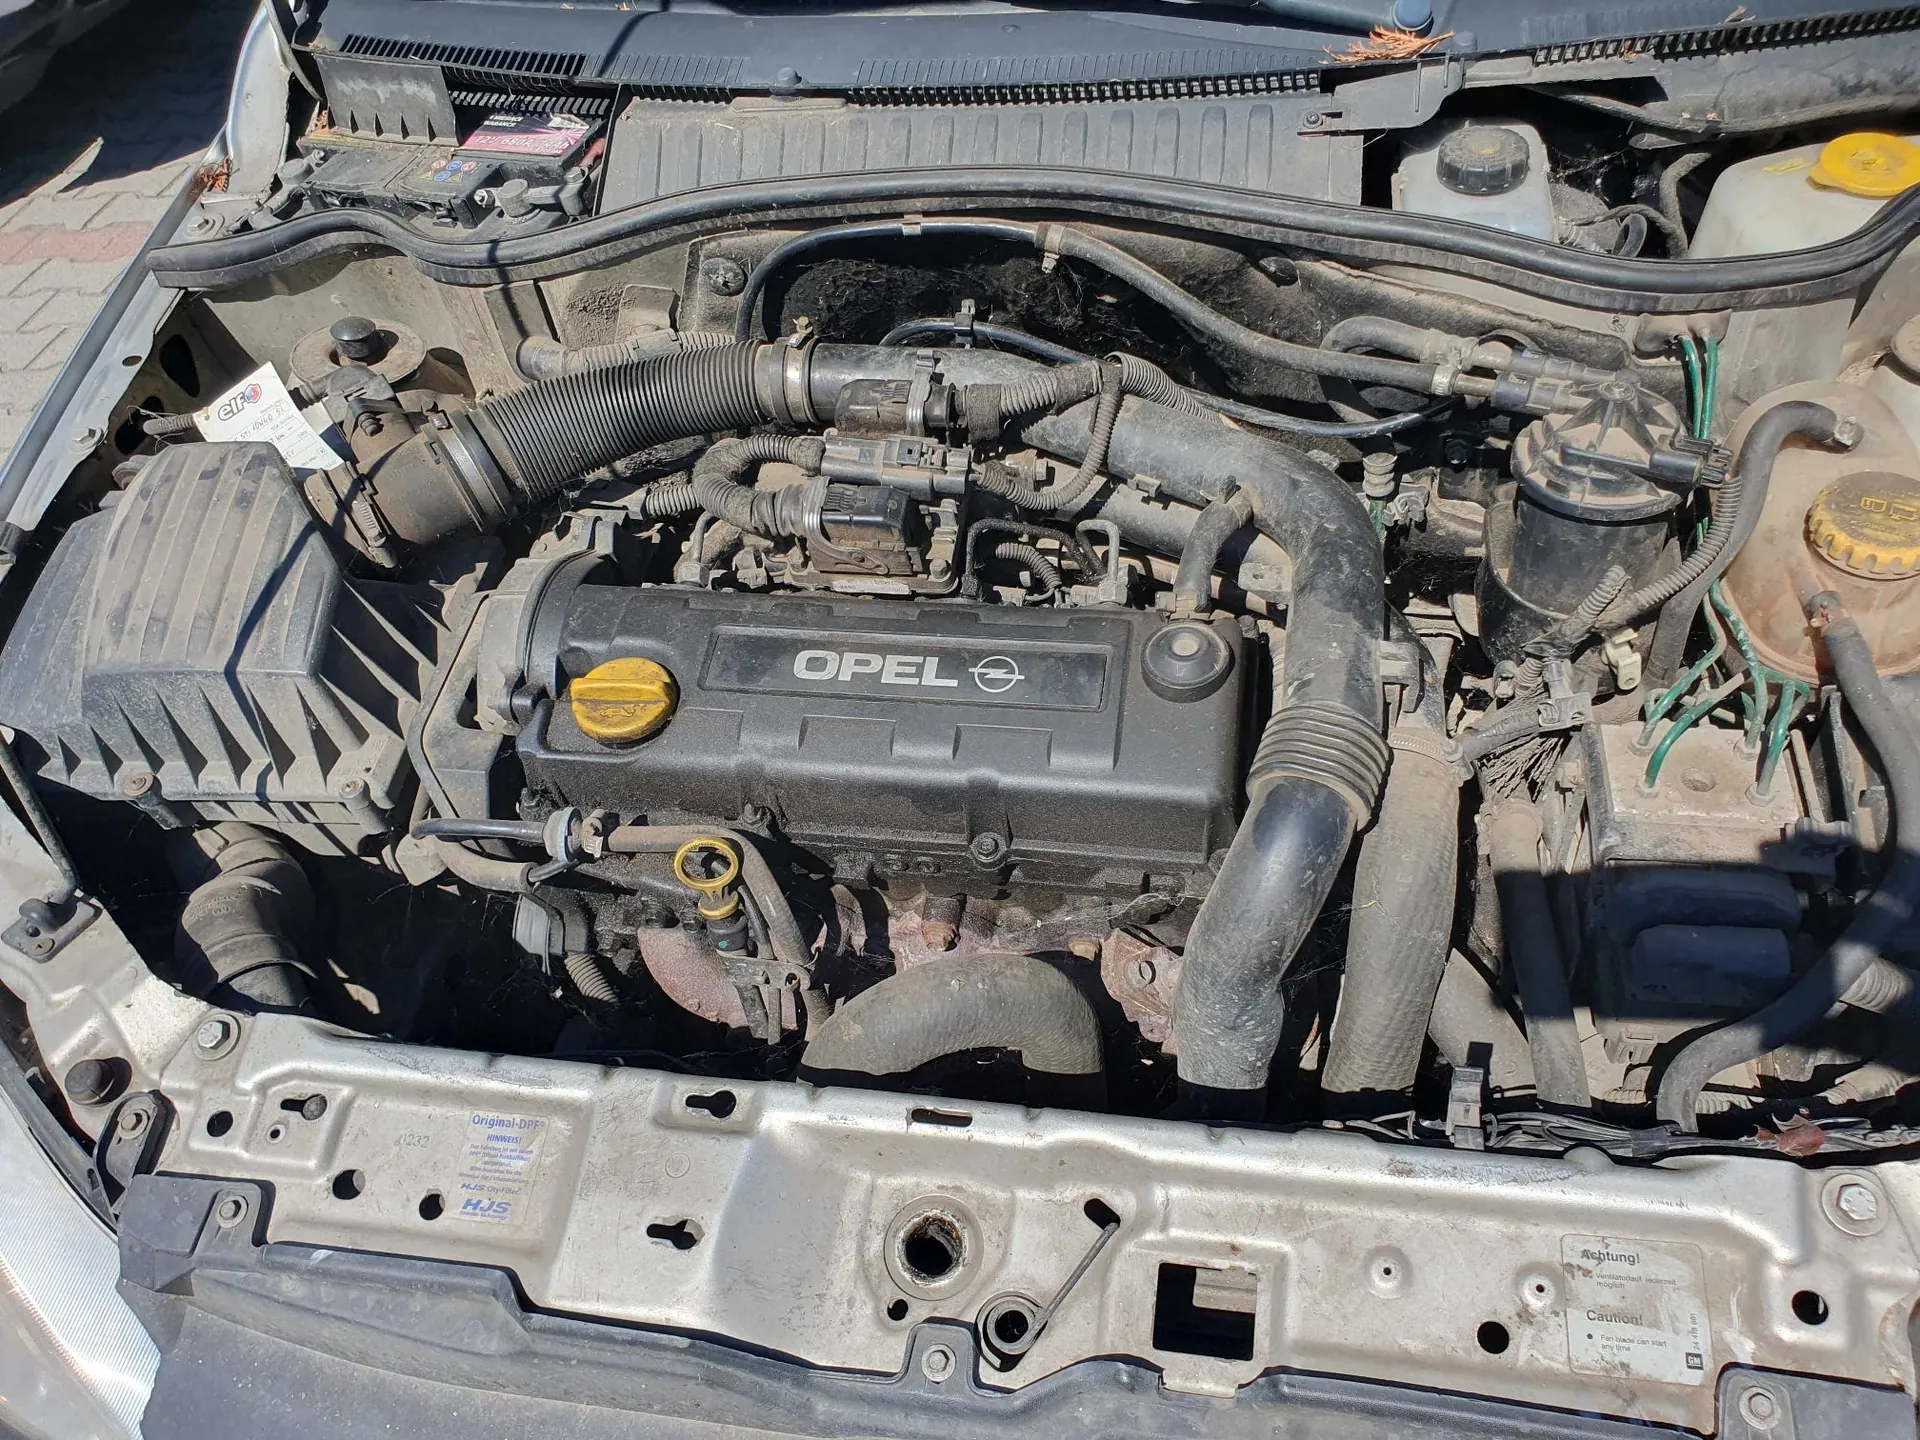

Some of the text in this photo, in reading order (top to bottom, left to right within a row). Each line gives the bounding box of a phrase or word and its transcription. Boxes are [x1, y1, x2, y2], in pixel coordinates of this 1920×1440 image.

[475, 135, 498, 144] 12V
[218, 391, 246, 421] elf
[793, 649, 959, 688] OPEL
[486, 1133, 523, 1144] HINWEIS!
[460, 1182, 486, 1191] HJS
[461, 1198, 512, 1214] HJS
[1580, 1249, 1641, 1266] Achtung!
[1596, 1281, 1626, 1290] möglich
[1586, 1309, 1644, 1326] Caution!
[1600, 1334, 1614, 1342] Fan
[1614, 1335, 1635, 1344] blade
[1651, 1339, 1667, 1347] start
[1601, 1344, 1631, 1352] any time
[1687, 1355, 1702, 1367] GM
